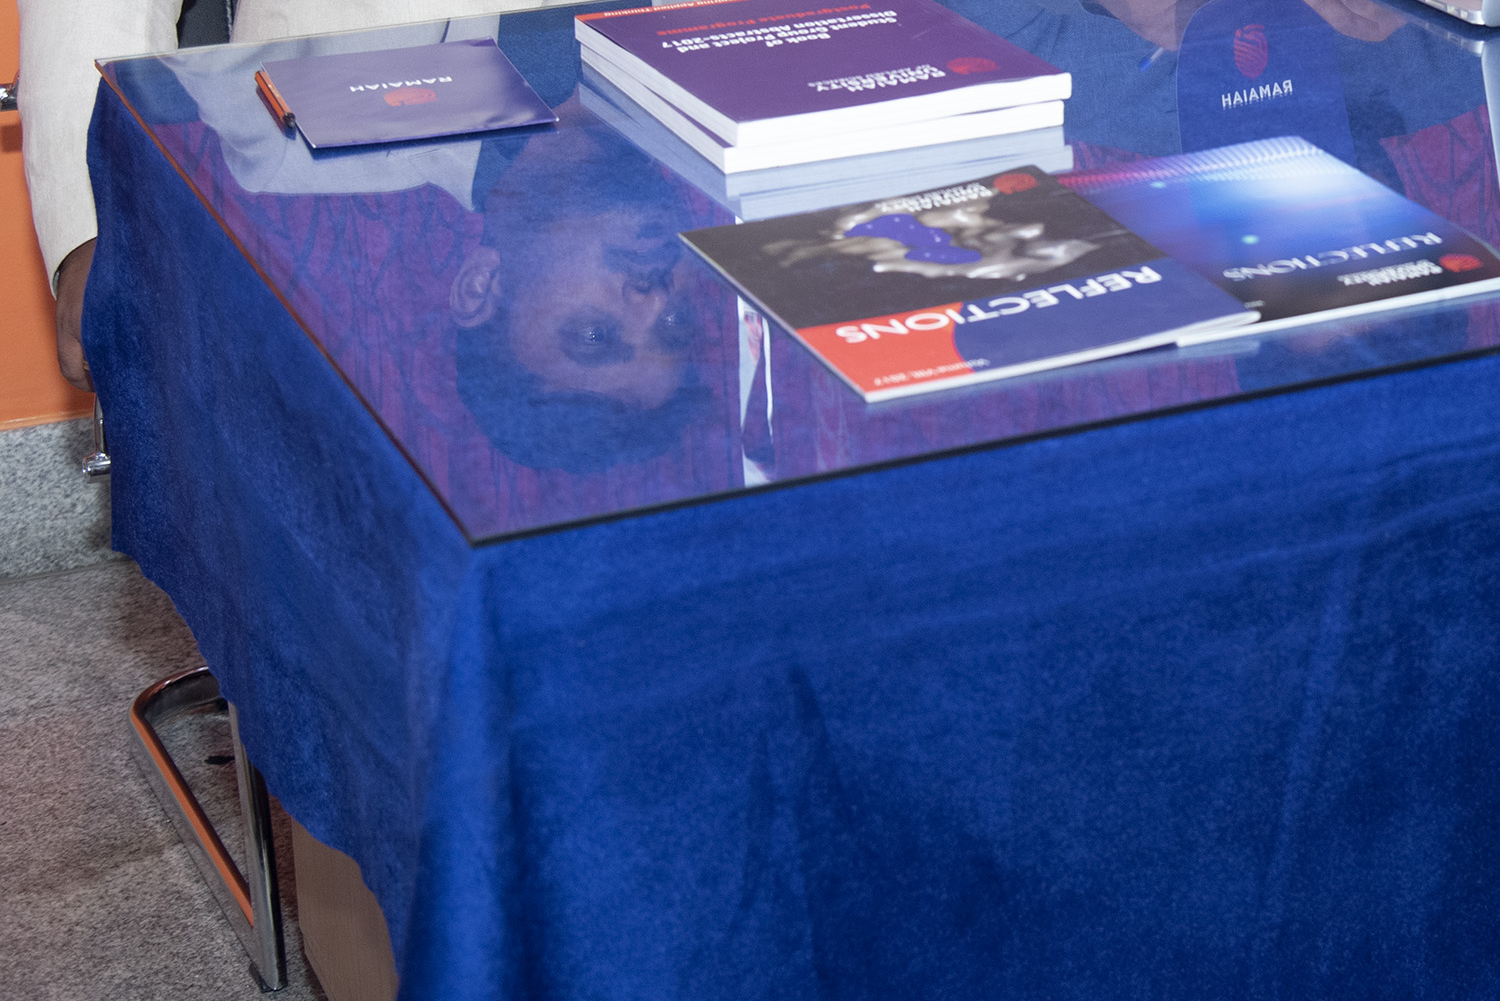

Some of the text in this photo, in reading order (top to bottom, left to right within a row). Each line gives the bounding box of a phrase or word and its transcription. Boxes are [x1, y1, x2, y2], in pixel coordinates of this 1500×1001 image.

[661, 10, 898, 49] Dissertation Abstracts-2017
[676, 17, 898, 54] Student Group Project and
[766, 33, 831, 48] Book of
[350, 76, 452, 92] RAMAIAH
[1222, 232, 1442, 282] REFLECTIONS
[836, 265, 1162, 344] REFLECTIONS
